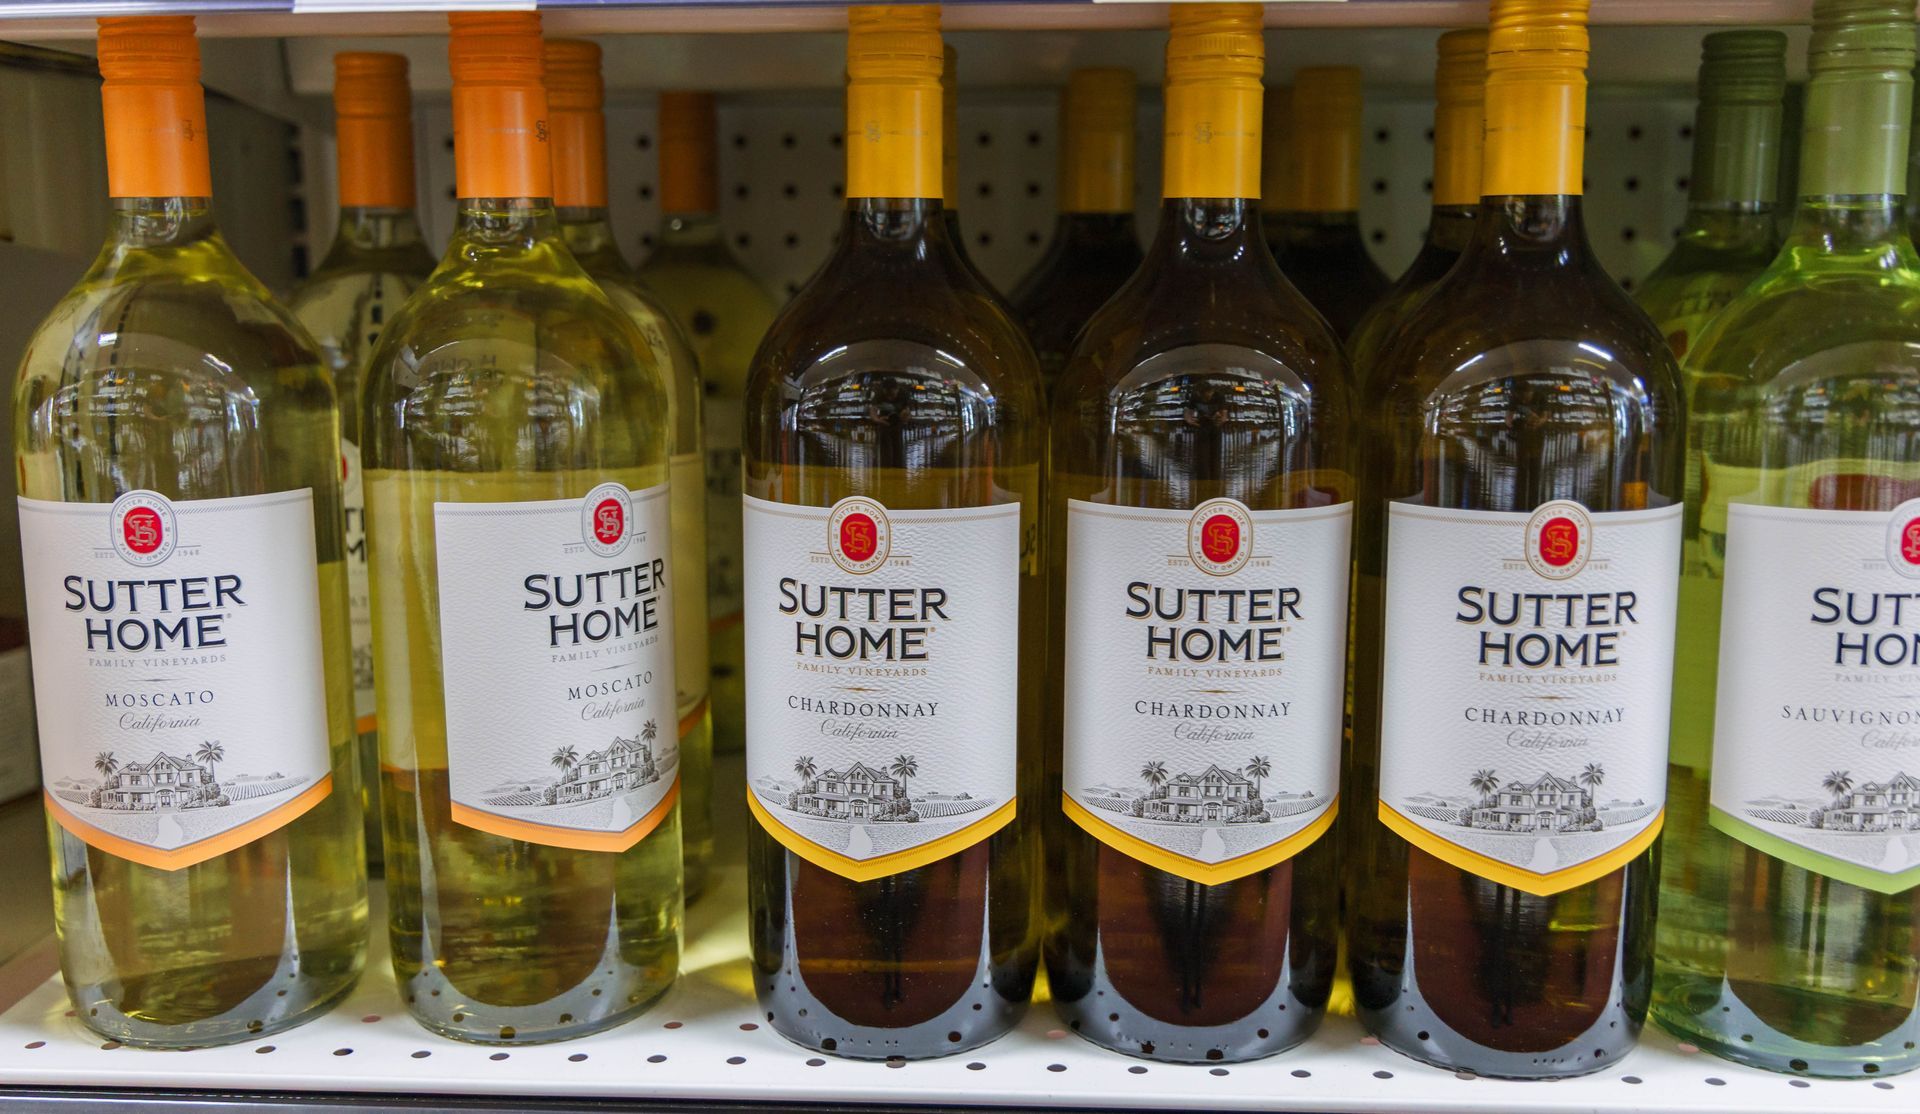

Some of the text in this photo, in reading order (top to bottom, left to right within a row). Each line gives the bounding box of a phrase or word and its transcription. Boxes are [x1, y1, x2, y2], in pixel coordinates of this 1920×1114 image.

[64, 575, 248, 614] SUTTER
[524, 558, 666, 611] SUTTER
[779, 577, 951, 622] SUTTER
[1126, 581, 1304, 624] SUTTER
[1455, 585, 1639, 629] SUTTER
[1811, 587, 1920, 626] SUT
[85, 614, 228, 652] HOME
[549, 597, 658, 648] HOME
[552, 635, 659, 663] FAMILY VINEYARDS
[796, 621, 929, 662] HOME
[1146, 625, 1284, 663] HOME
[1478, 631, 1620, 669] HOME
[89, 654, 227, 668] FAMILY VINEYARDS
[797, 662, 927, 677] FAMILY VINEYARDS
[1148, 667, 1283, 678] FAMILY VINEYARDS
[568, 671, 653, 701] MOSCATO
[1479, 672, 1617, 684] FAMILY VINEYARDS
[105, 690, 214, 707] MOSCATO
[581, 697, 645, 721] California
[788, 695, 939, 718] CHARDONNAY
[1135, 701, 1290, 719] CHARDONNAY
[119, 711, 201, 733] California
[820, 718, 900, 741] California
[1464, 707, 1625, 726] CHARDONNAY
[1174, 721, 1255, 744] California
[1506, 728, 1590, 751] California
